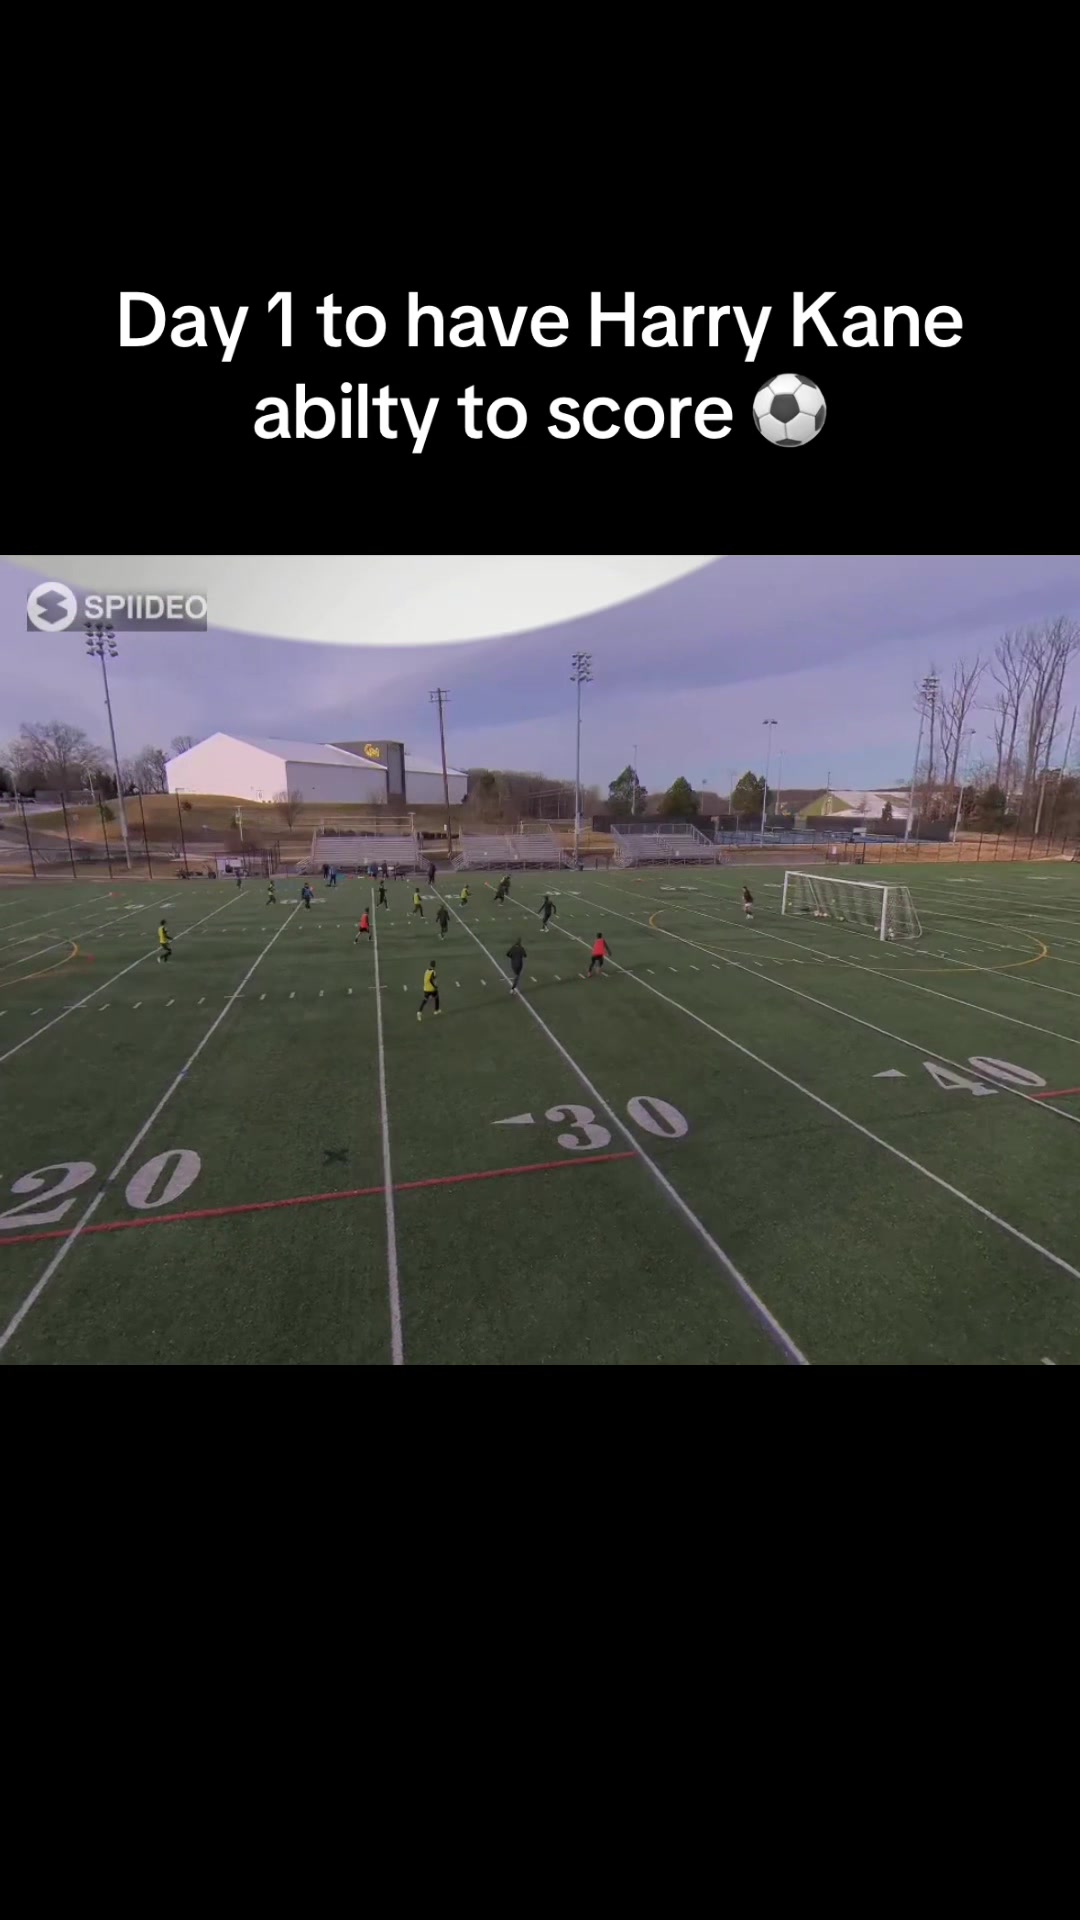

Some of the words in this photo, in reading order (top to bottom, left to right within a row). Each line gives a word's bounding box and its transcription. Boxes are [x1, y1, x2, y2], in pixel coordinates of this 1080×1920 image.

[923, 1056, 1047, 1097] 40
[545, 1096, 689, 1151] 30
[0, 1149, 201, 1229] 20
